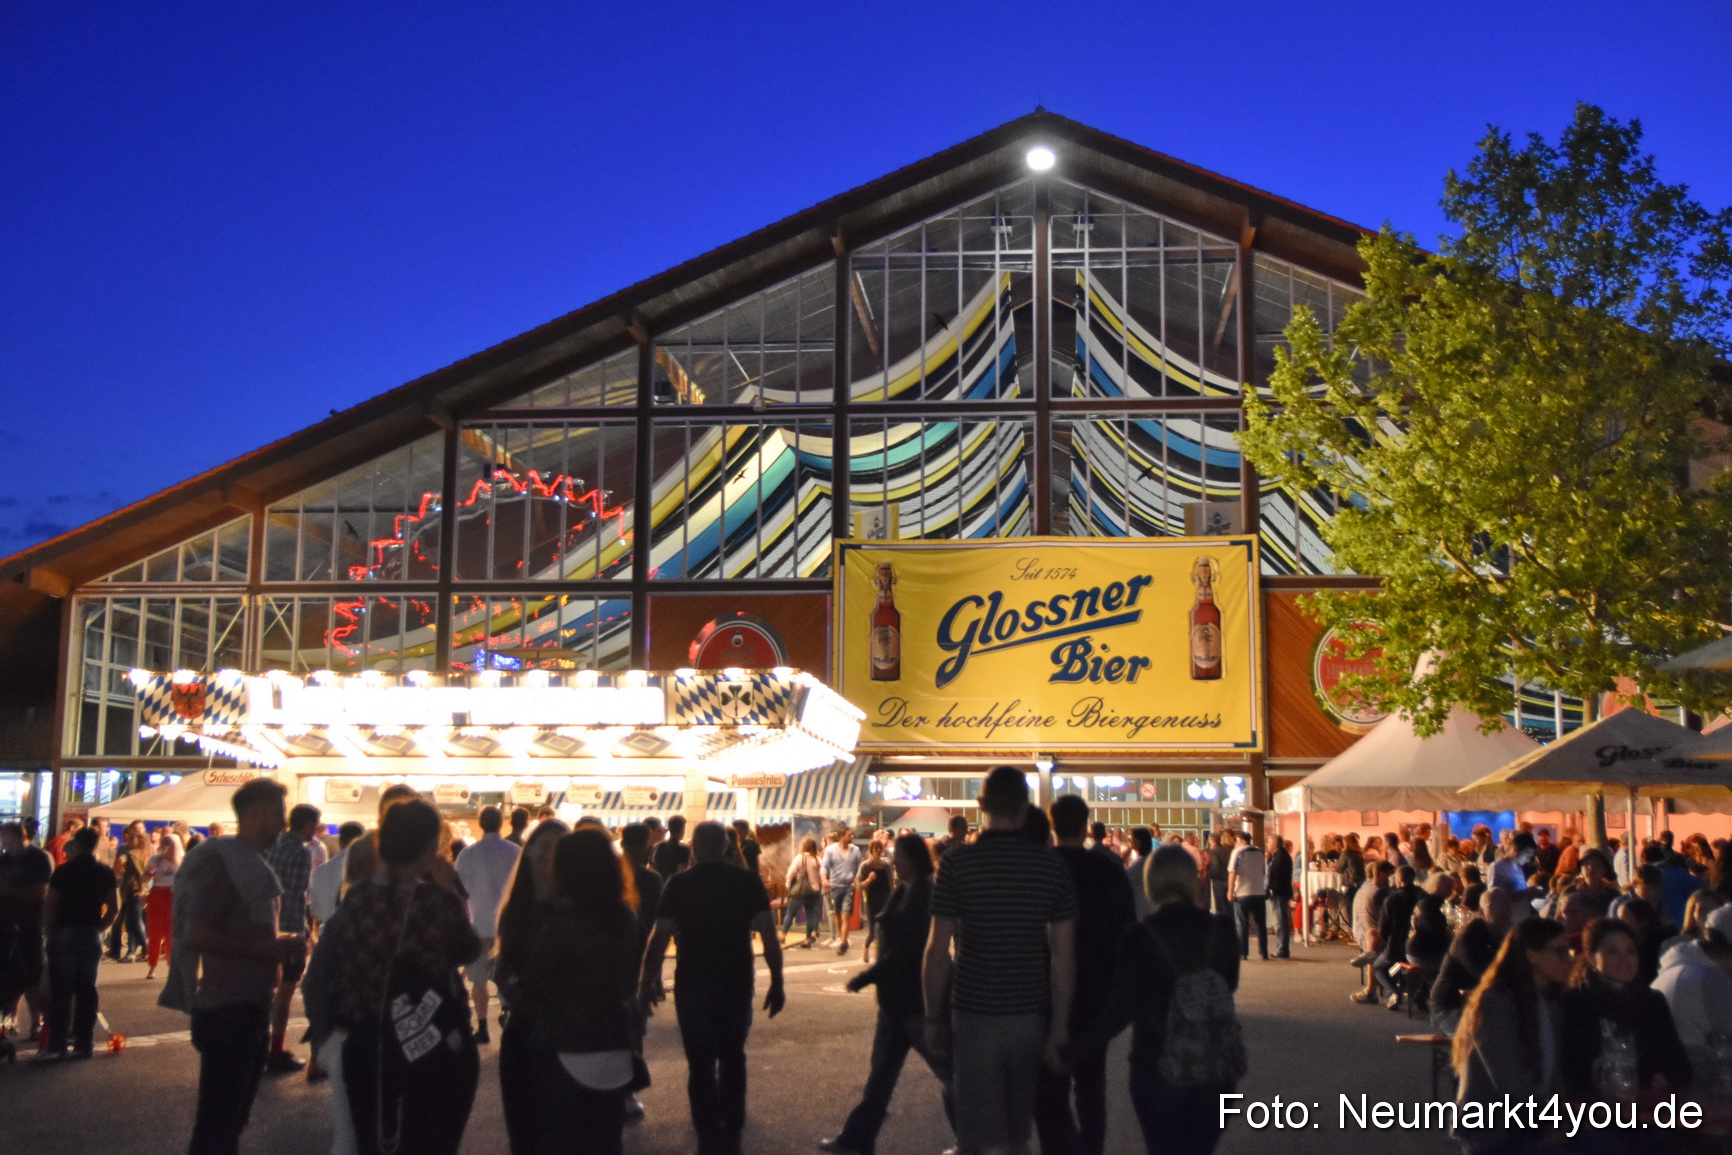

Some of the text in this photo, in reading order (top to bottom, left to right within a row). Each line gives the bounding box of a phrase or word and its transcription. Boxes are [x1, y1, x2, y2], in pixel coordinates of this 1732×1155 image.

[1010, 557, 1078, 581] Seit 1574
[935, 574, 1153, 689] Glossner
[1049, 635, 1151, 685] Bier
[872, 695, 1221, 739] Der hochfeine Biergenuss
